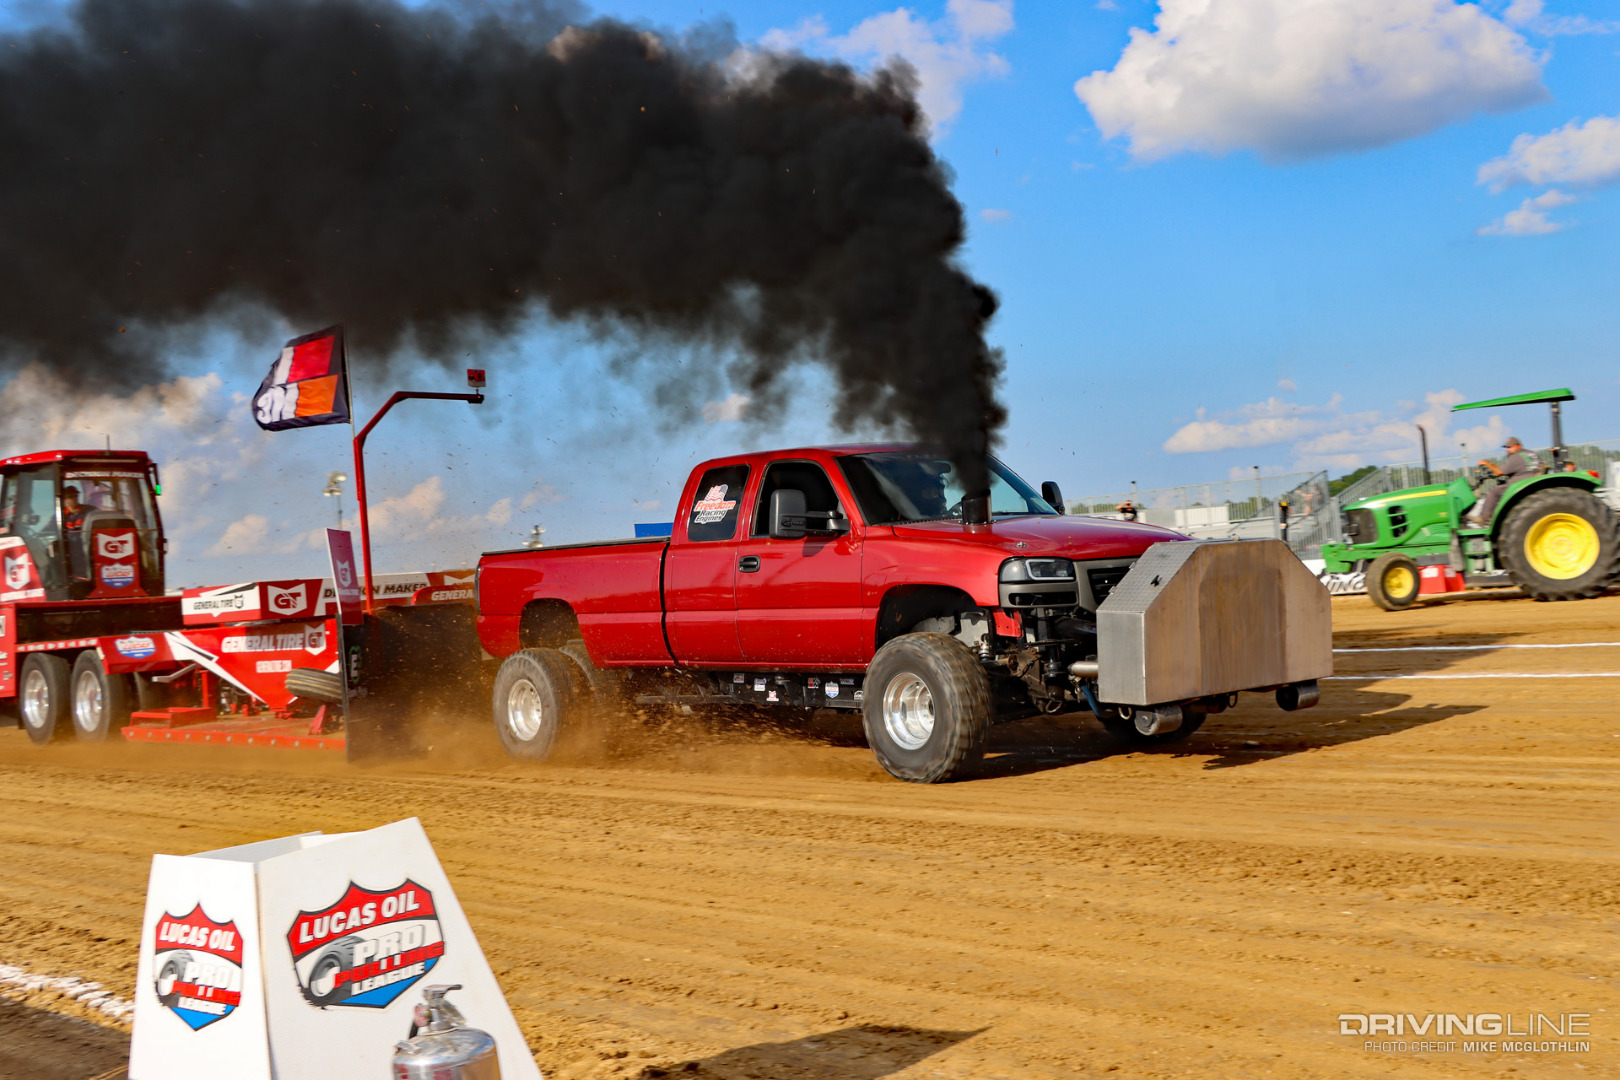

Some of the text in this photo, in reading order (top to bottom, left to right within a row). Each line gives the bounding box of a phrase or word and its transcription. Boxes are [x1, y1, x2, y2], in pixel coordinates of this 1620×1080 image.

[694, 501, 736, 511] Freedom
[696, 515, 722, 523] Engines
[104, 540, 128, 553] GT
[193, 600, 219, 610] GENERAL
[220, 599, 233, 608] TIRE
[274, 592, 302, 609] GT
[221, 635, 275, 653] GENERAL
[275, 633, 304, 651] TIRE
[299, 890, 420, 943] LUCAS OIL
[159, 922, 236, 951] LUCAS OIL
[352, 924, 426, 968] PRO
[333, 941, 445, 988] PULLING
[182, 961, 231, 989] PRO
[351, 961, 426, 996] LEAGUE
[178, 996, 227, 1016] LEAGUE
